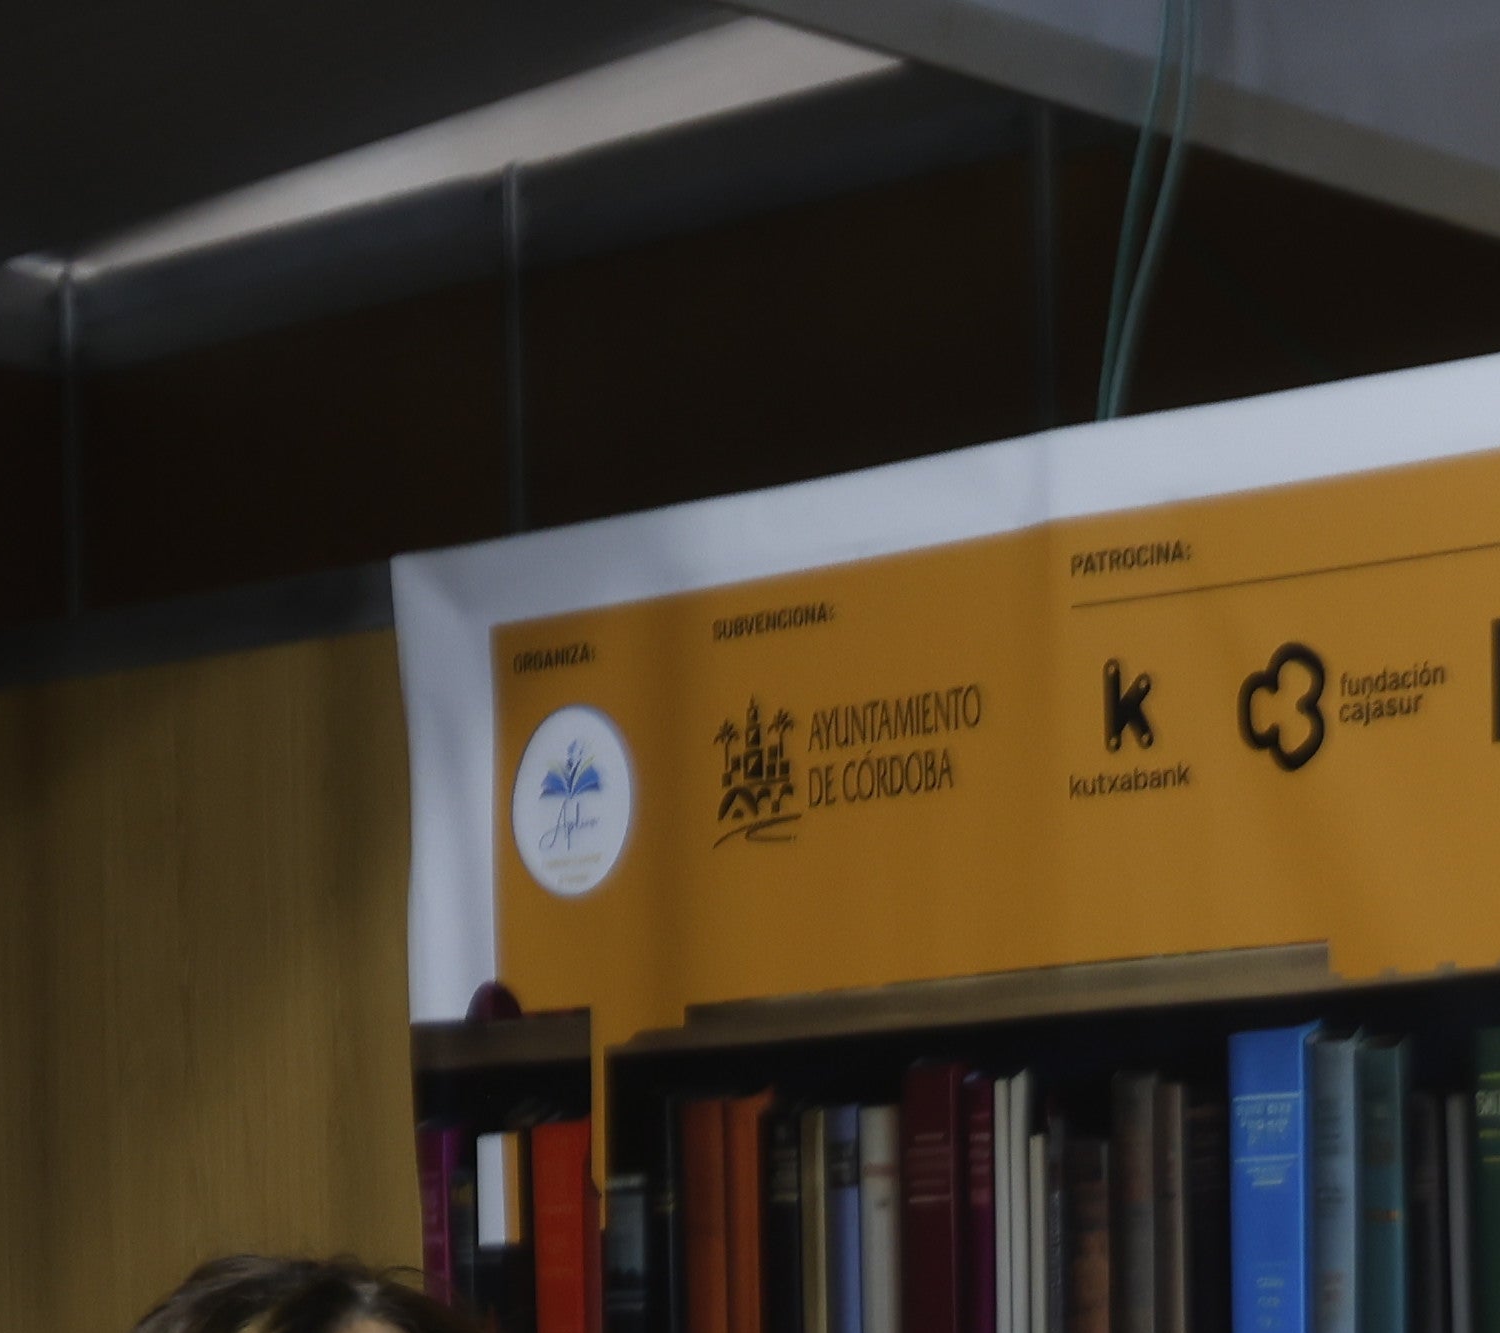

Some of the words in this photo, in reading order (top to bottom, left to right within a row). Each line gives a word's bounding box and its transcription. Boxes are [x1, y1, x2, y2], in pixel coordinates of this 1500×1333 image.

[1070, 540, 1192, 577] PATROCINA:
[713, 602, 835, 640] SUBVENCIONA:
[513, 642, 595, 674] ORGANIZA:
[1340, 660, 1445, 697] fundación
[807, 684, 981, 752] AYUNTAMIENTO
[1339, 693, 1423, 727] cajasur
[808, 764, 836, 808] DE
[842, 748, 954, 804] CÓRDOBA
[1068, 762, 1191, 800] kutxabank
